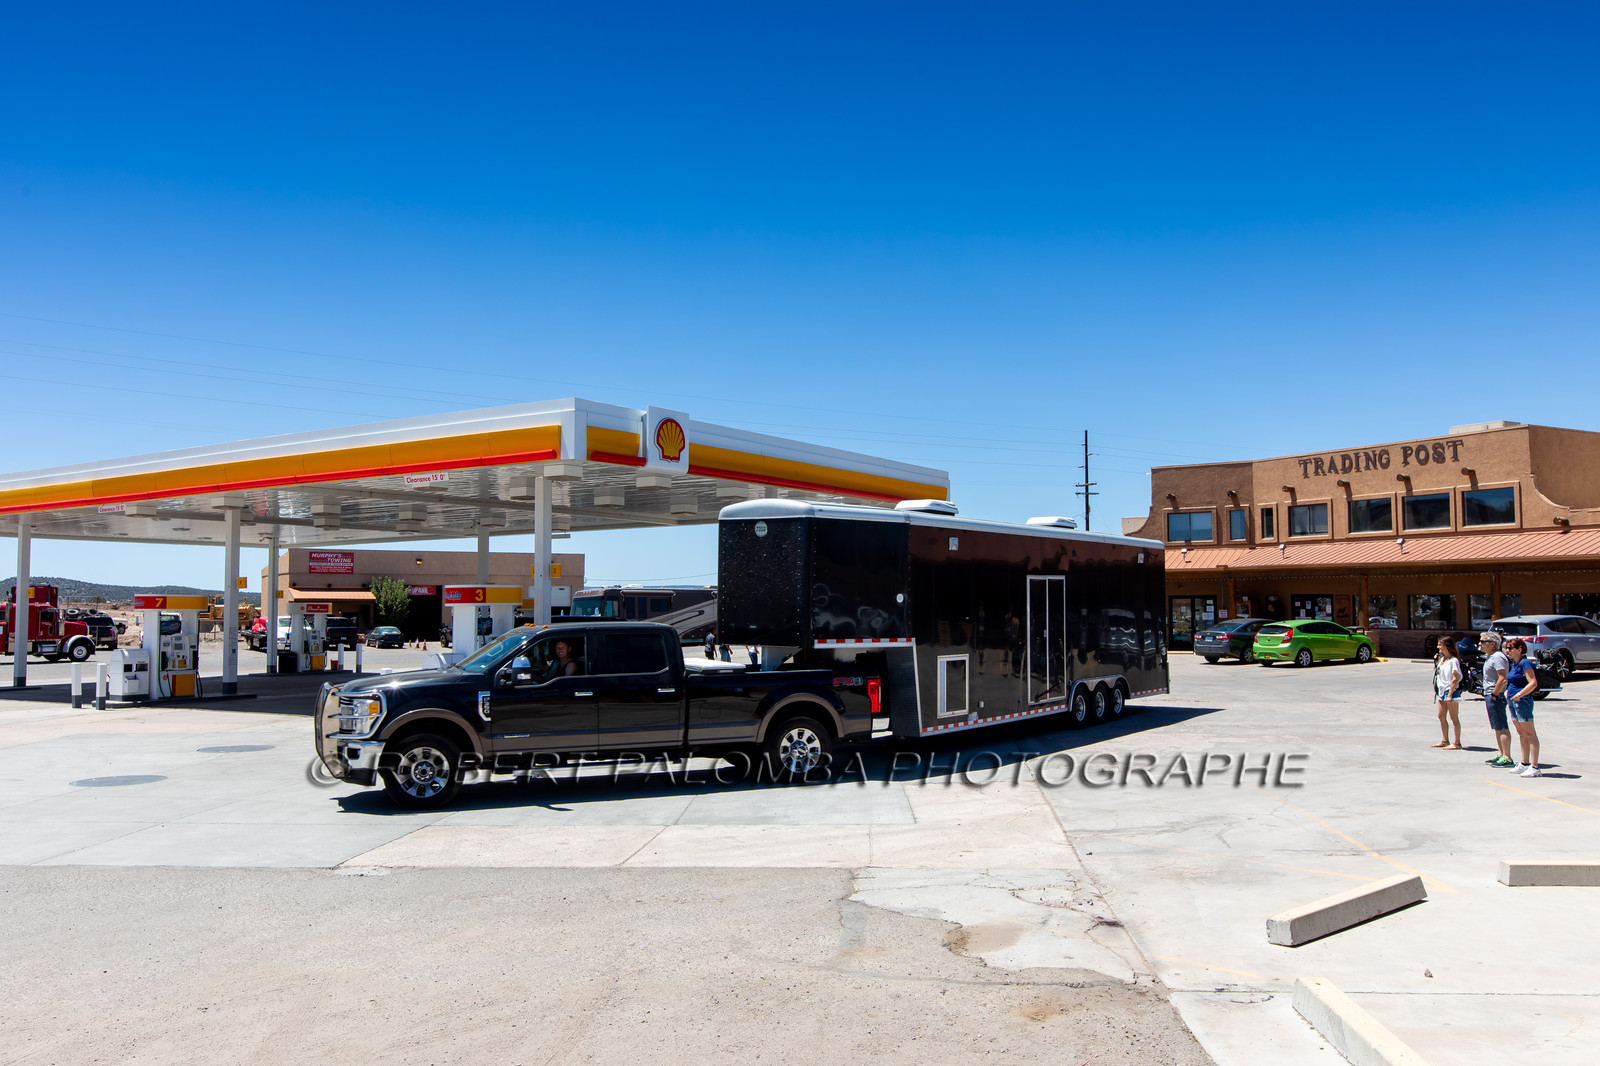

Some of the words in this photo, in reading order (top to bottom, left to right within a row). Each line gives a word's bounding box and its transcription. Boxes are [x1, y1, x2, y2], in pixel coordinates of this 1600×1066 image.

[1298, 448, 1391, 479] TRADING
[1400, 439, 1464, 468] POST
[406, 476, 431, 484] Clearance
[474, 589, 484, 602] 3
[155, 598, 164, 608] 7
